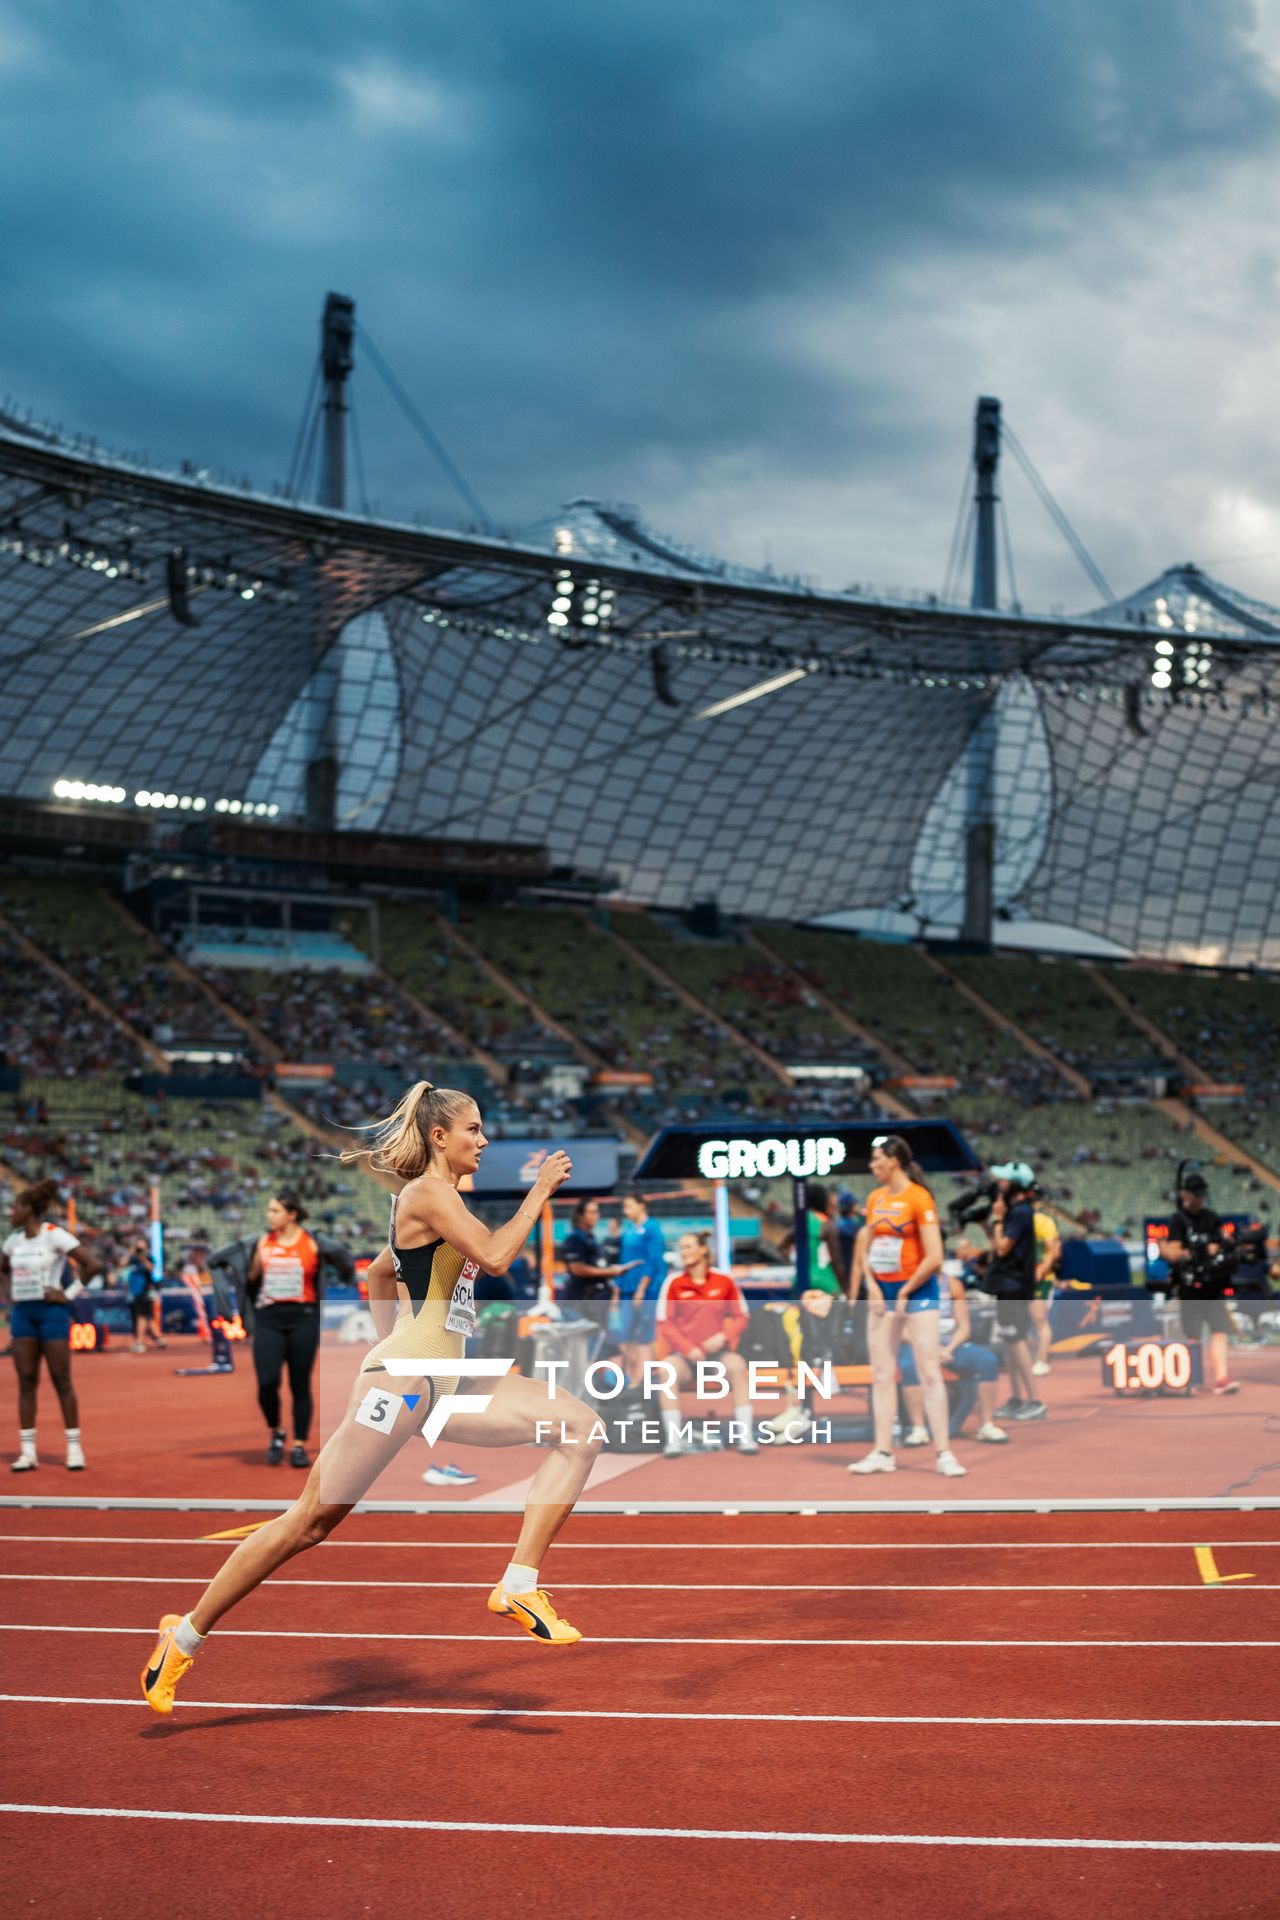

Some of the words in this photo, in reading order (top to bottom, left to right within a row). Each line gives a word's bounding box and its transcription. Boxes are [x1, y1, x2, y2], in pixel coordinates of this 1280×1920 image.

[698, 1137, 847, 1179] GROUP
[1104, 1342, 1192, 1389] 1:00
[369, 1397, 390, 1422] 5
